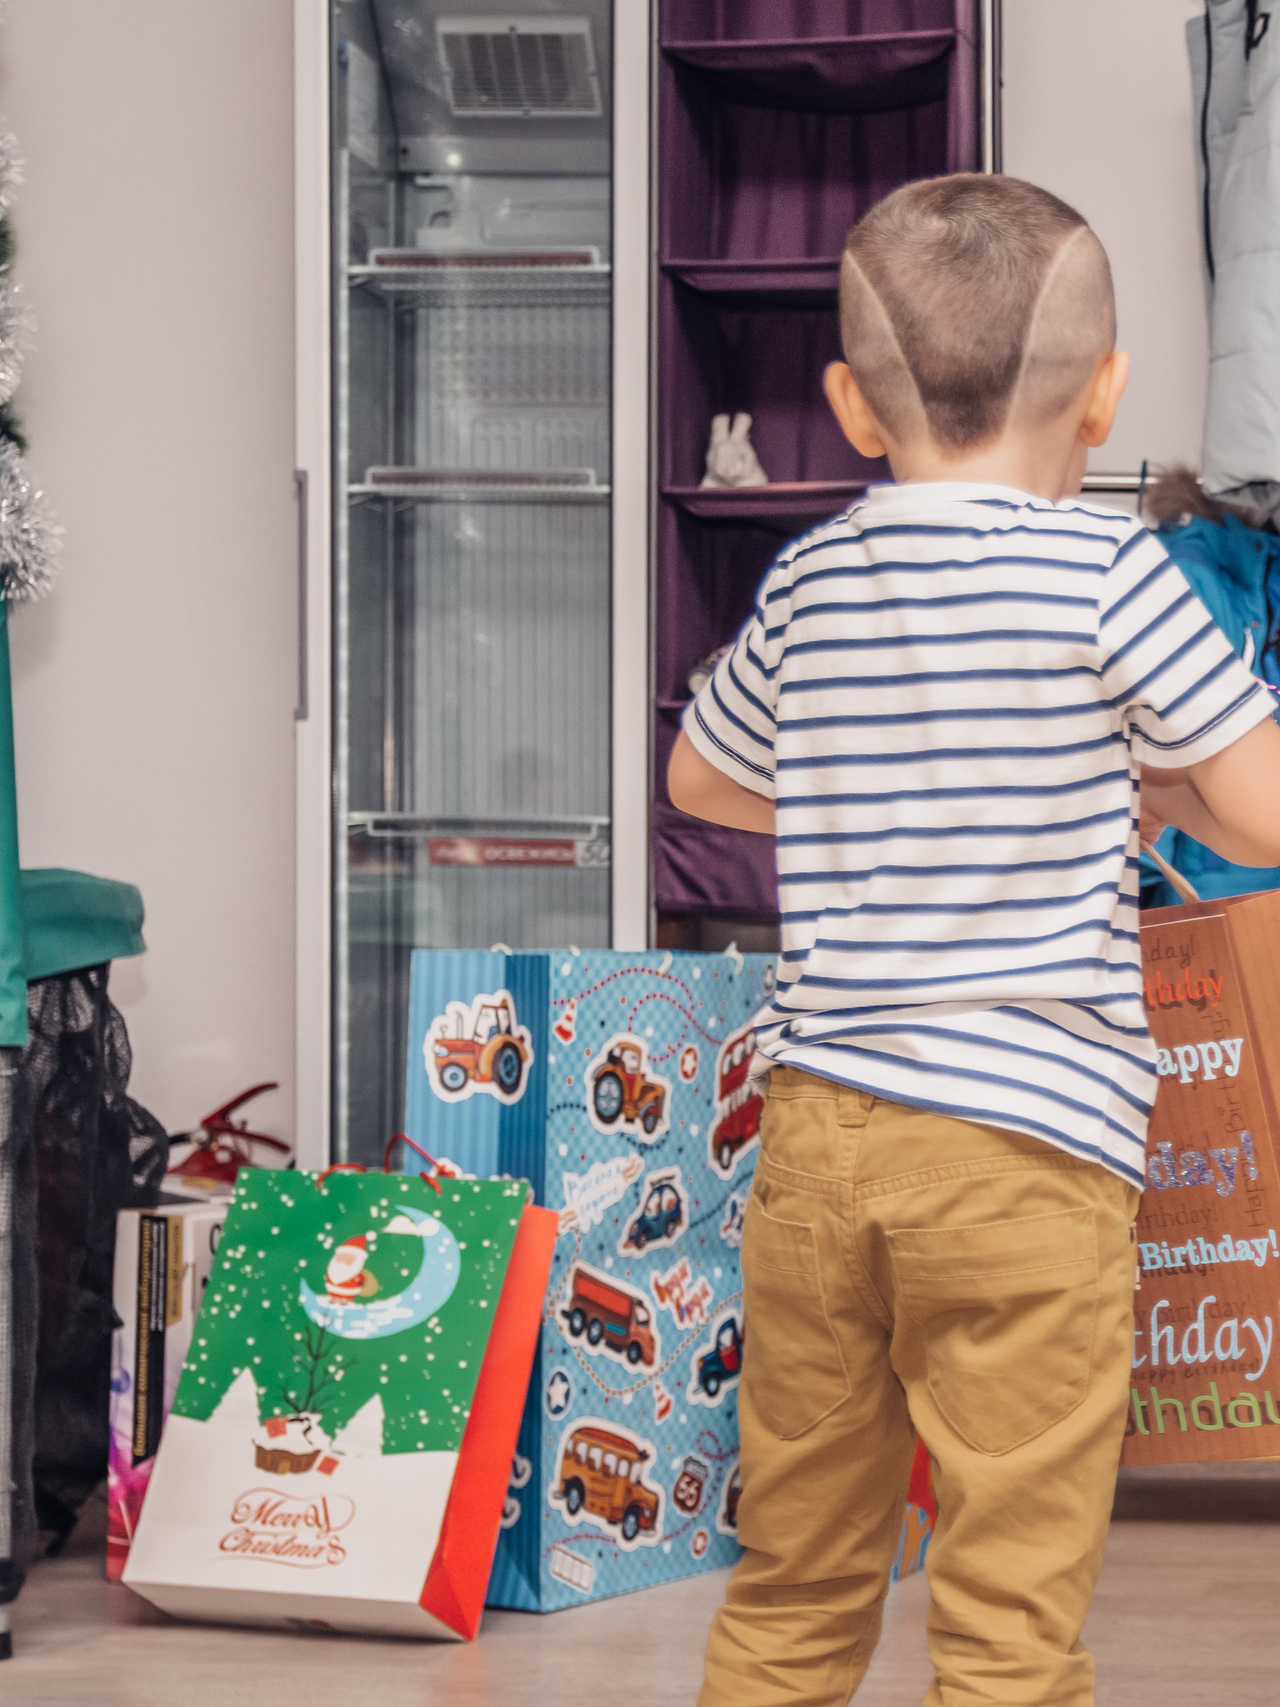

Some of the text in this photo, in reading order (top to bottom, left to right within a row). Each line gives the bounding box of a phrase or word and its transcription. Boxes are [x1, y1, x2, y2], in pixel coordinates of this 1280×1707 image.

[1145, 1130, 1259, 1198] day!
[1138, 1229, 1280, 1270] Birthday!
[231, 1491, 345, 1540] Merry
[218, 1527, 347, 1566] Christmas
